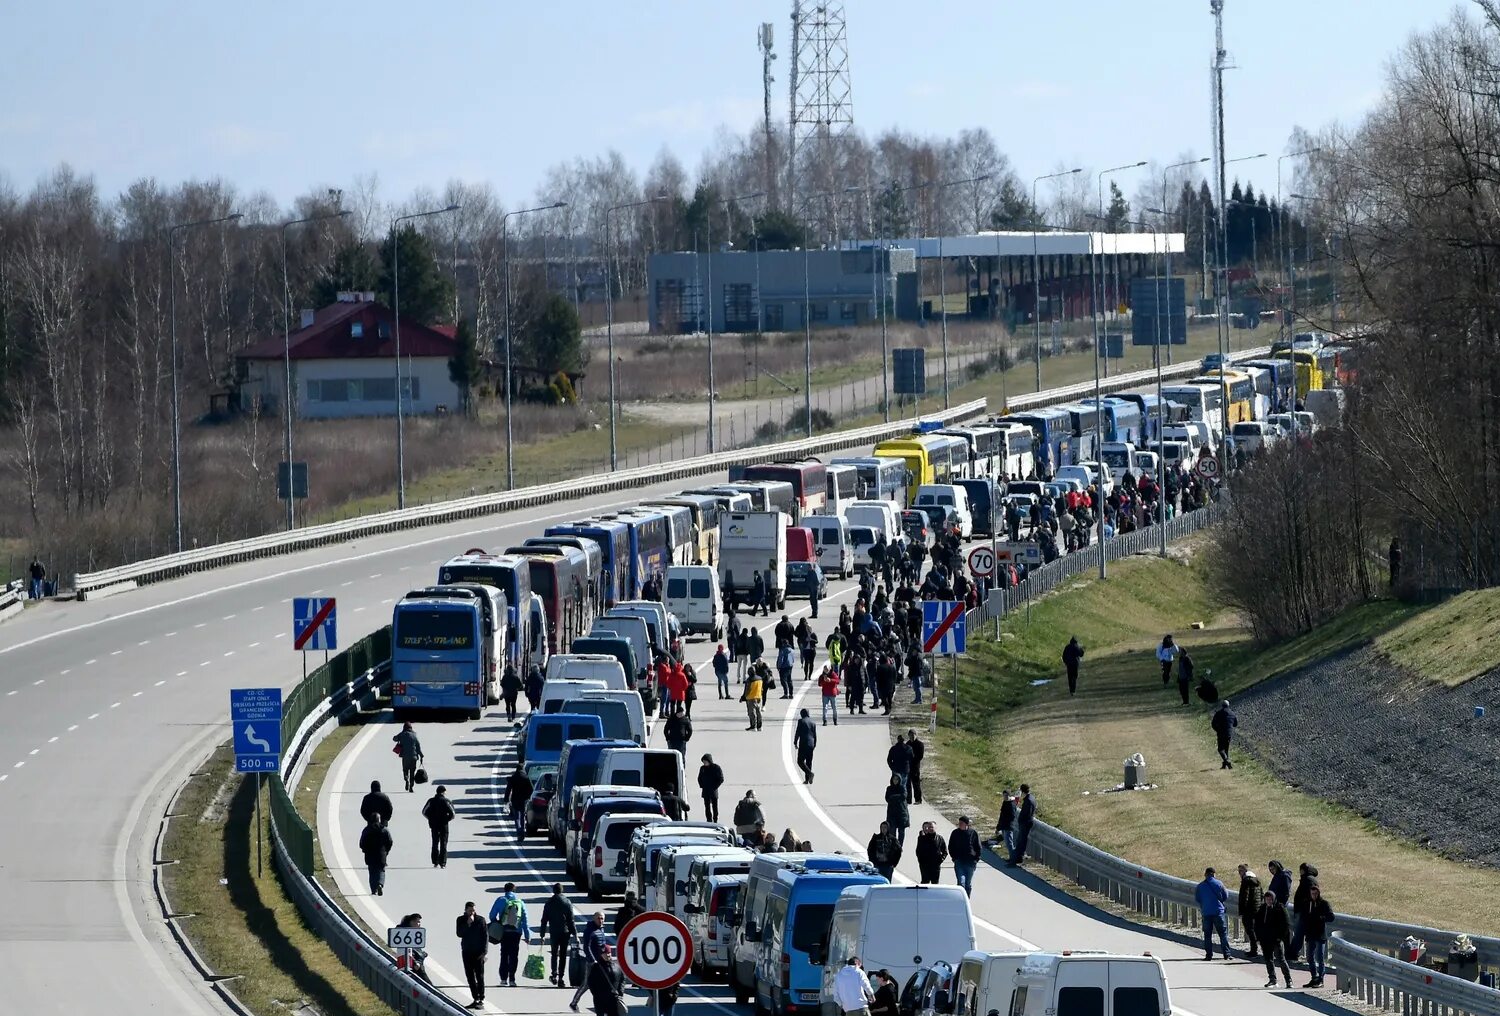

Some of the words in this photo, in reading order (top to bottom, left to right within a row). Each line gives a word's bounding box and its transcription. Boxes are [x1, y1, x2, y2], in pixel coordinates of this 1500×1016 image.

[1201, 461, 1216, 472] 50
[974, 555, 993, 569] 70
[241, 759, 261, 768] 500
[393, 931, 423, 945] 668
[628, 936, 682, 965] 100
